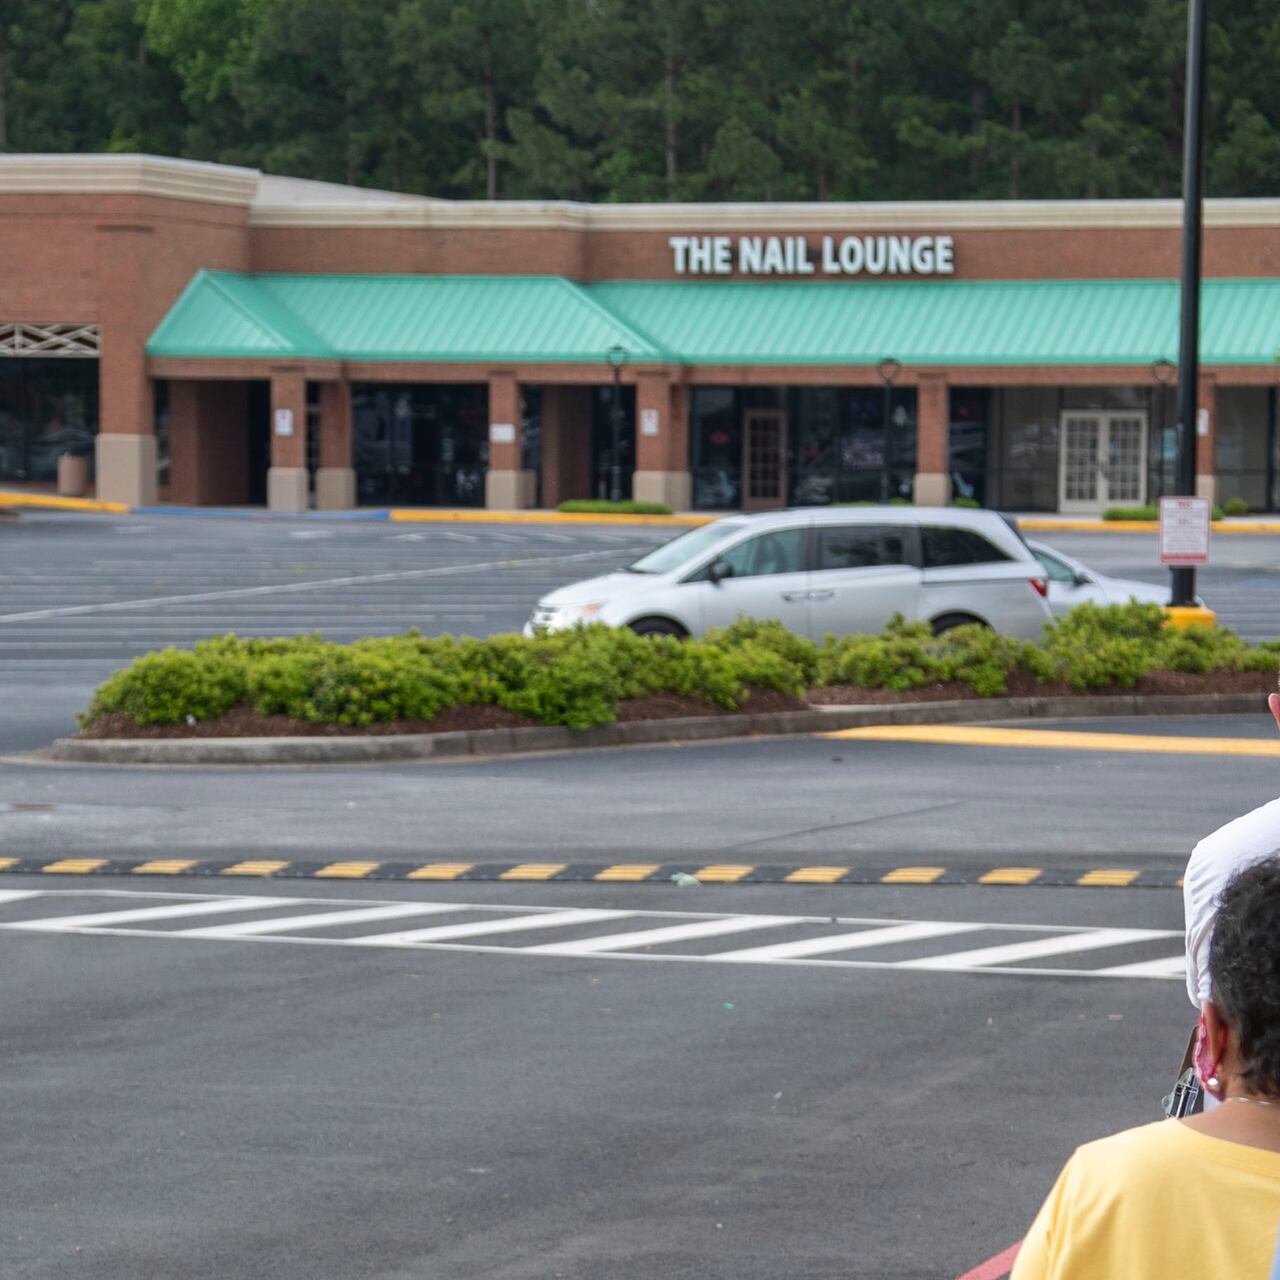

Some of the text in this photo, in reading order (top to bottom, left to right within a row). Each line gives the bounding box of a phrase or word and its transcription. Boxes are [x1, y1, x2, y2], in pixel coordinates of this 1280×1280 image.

[669, 236, 955, 274] THE NAIL LOUNGE
